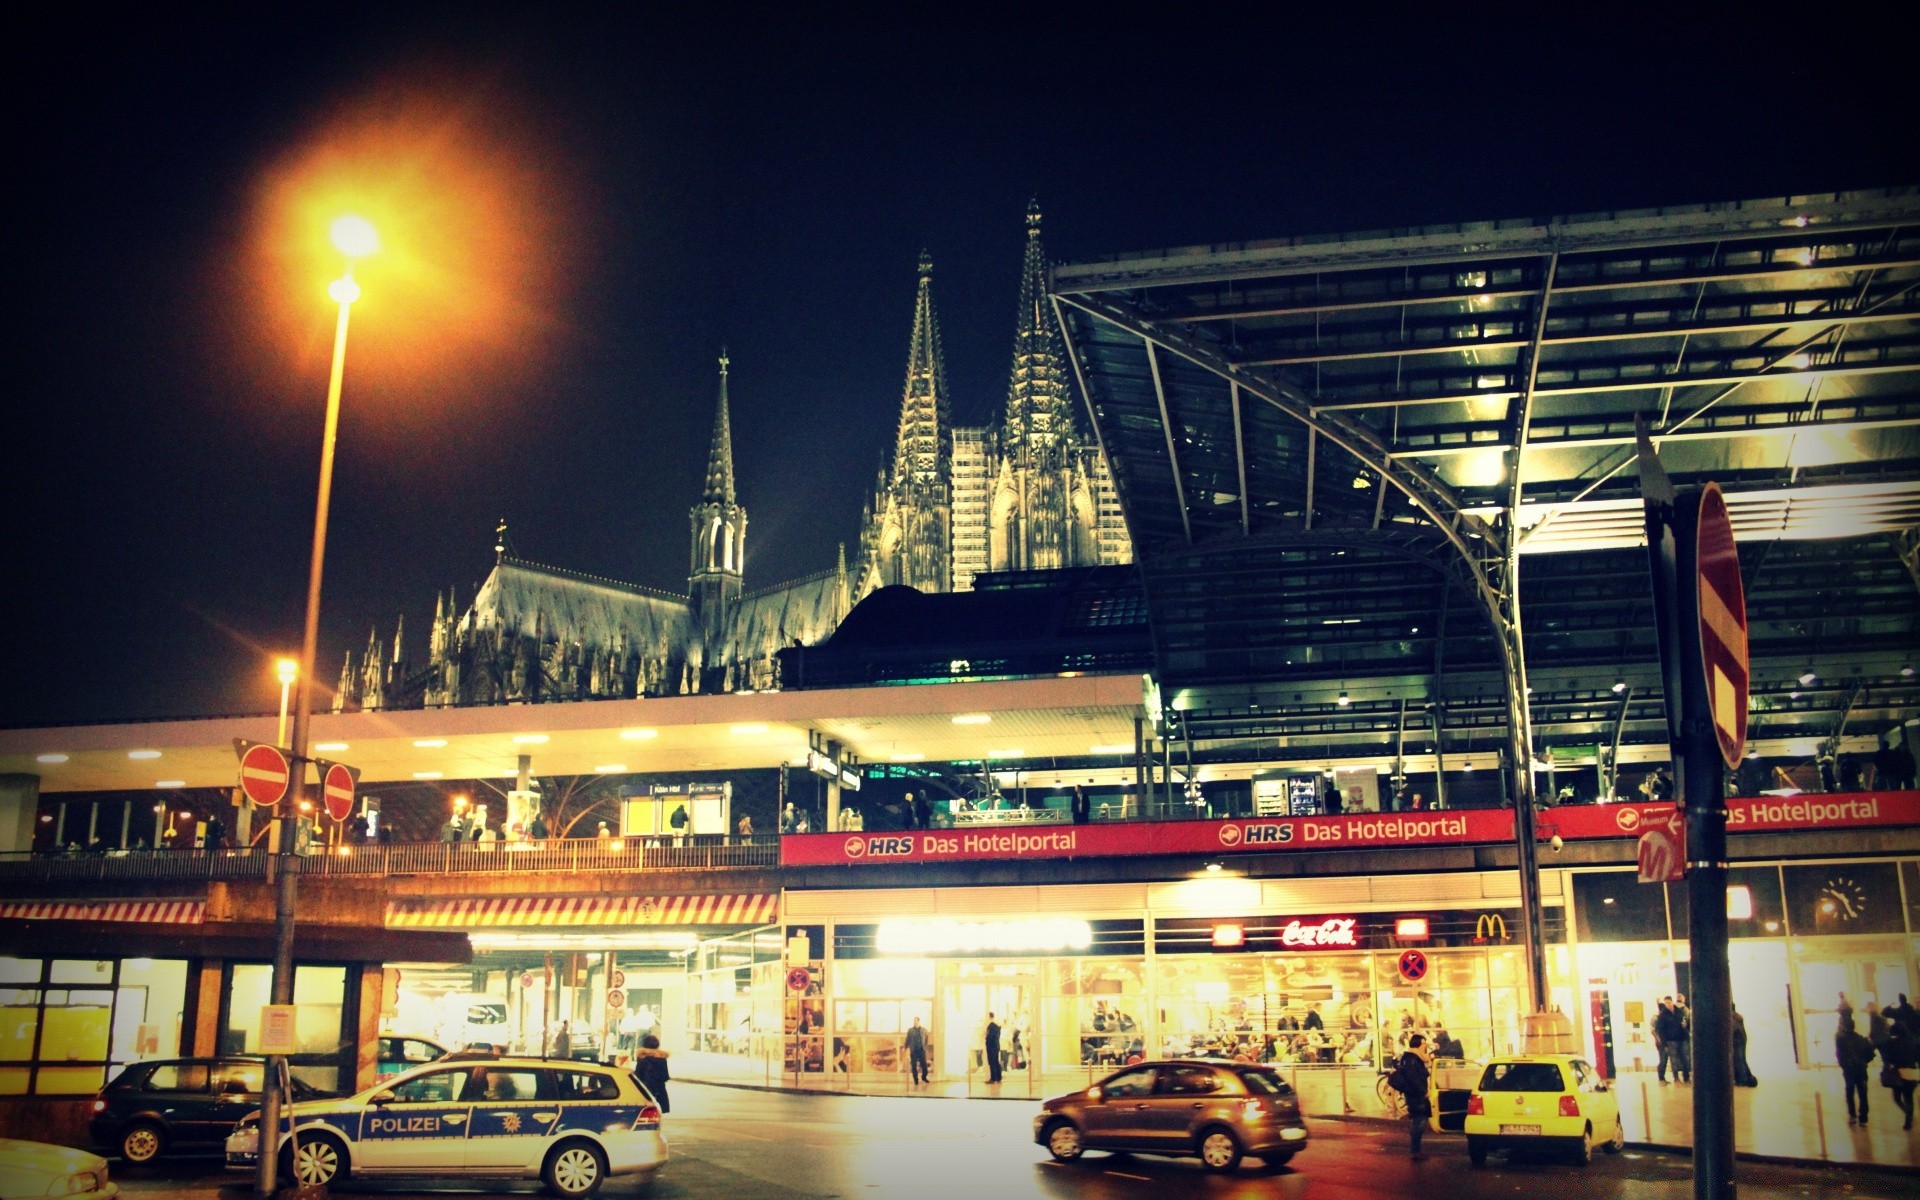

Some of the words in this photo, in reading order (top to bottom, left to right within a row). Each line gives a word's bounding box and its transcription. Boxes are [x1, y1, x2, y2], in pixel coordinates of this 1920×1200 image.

[655, 783, 668, 793] Köln
[1725, 807, 1745, 824] as
[1751, 799, 1879, 824] Hotelportal
[1244, 824, 1294, 844] HRS
[1304, 823, 1341, 842] Das
[1348, 816, 1467, 841] Hotelportal
[1640, 816, 1669, 827] Museum
[868, 836, 915, 857] HRS
[923, 836, 958, 854] Das
[964, 832, 1076, 854] Hotelportal
[371, 1118, 440, 1132] POLIZEI
